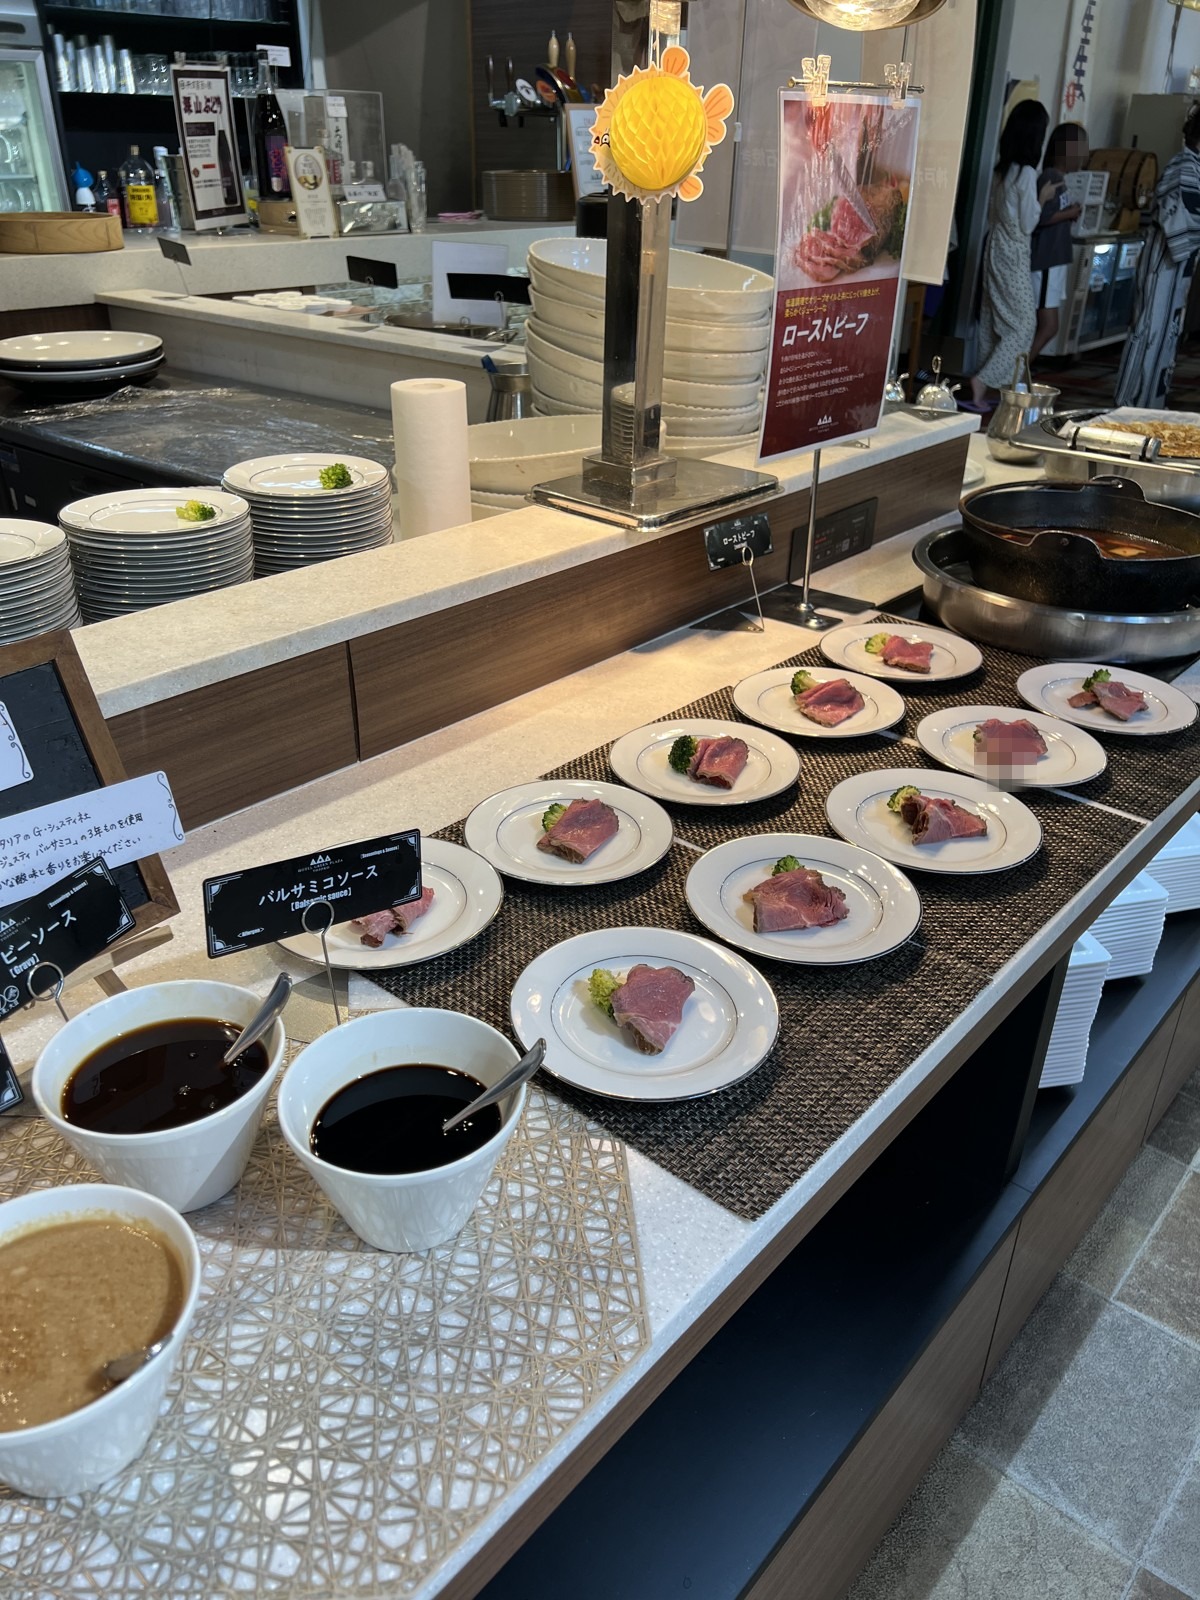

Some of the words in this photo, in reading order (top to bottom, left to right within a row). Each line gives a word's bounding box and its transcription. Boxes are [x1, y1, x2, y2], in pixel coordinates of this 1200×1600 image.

[782, 313, 869, 347] ローストビーフ
[722, 530, 756, 546] ローストビーフ
[258, 864, 379, 906] バルサミコソース
[0, 909, 77, 965] ビーソース
